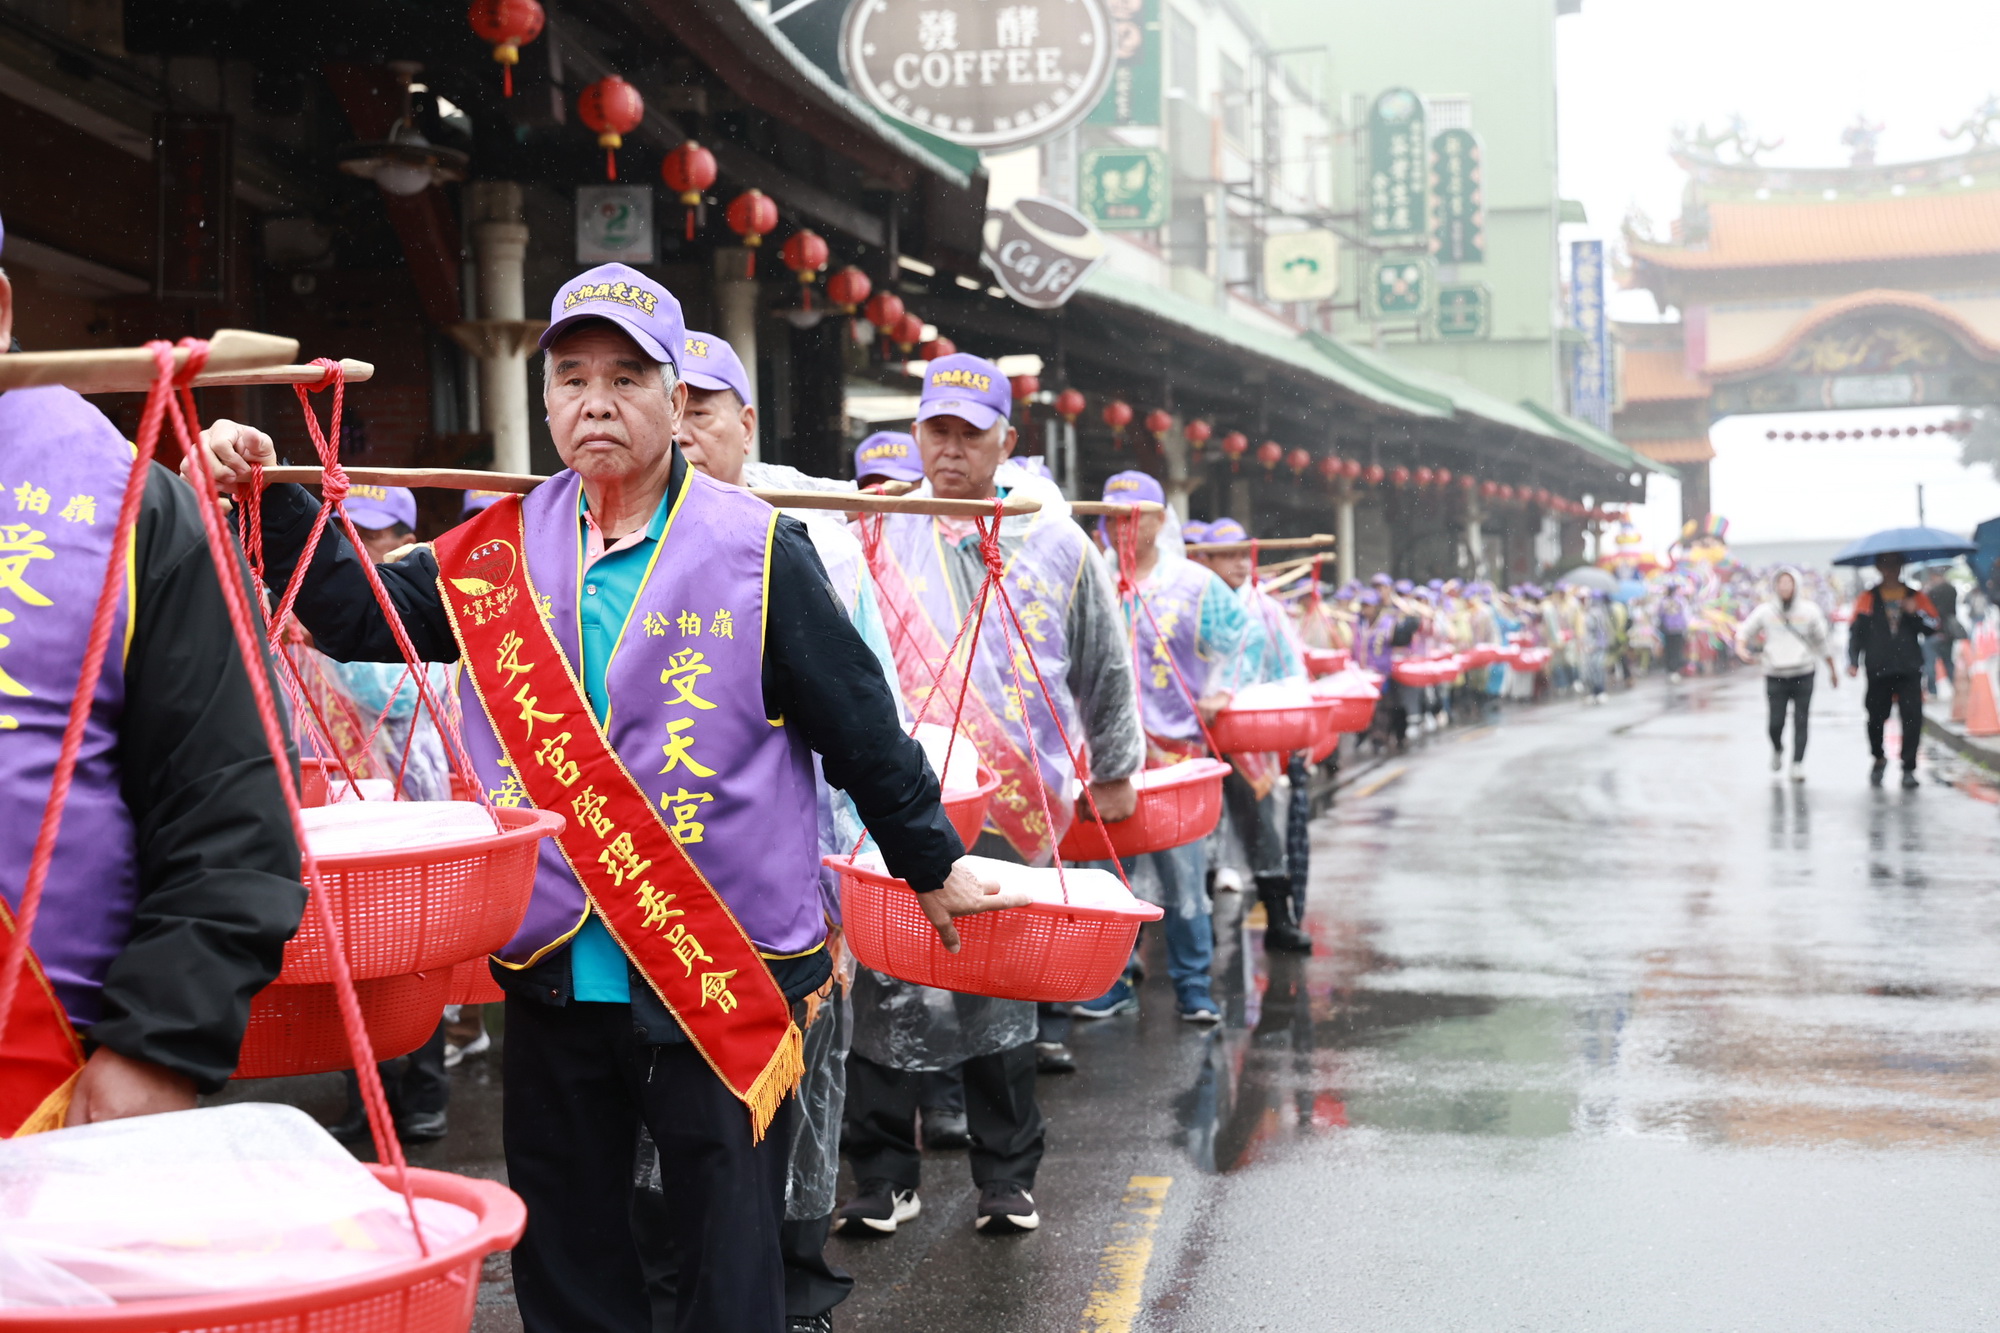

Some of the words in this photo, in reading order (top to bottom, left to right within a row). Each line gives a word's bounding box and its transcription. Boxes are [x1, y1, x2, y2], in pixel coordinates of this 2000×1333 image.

[893, 47, 1064, 90] COFFEE
[564, 282, 659, 313] 松柏嶺受天宮
[0, 481, 98, 525] 柏嶺
[642, 608, 735, 639] 松柏嶺
[658, 647, 718, 844] 受天宮
[496, 630, 738, 1014] 受天宮管理委員會
